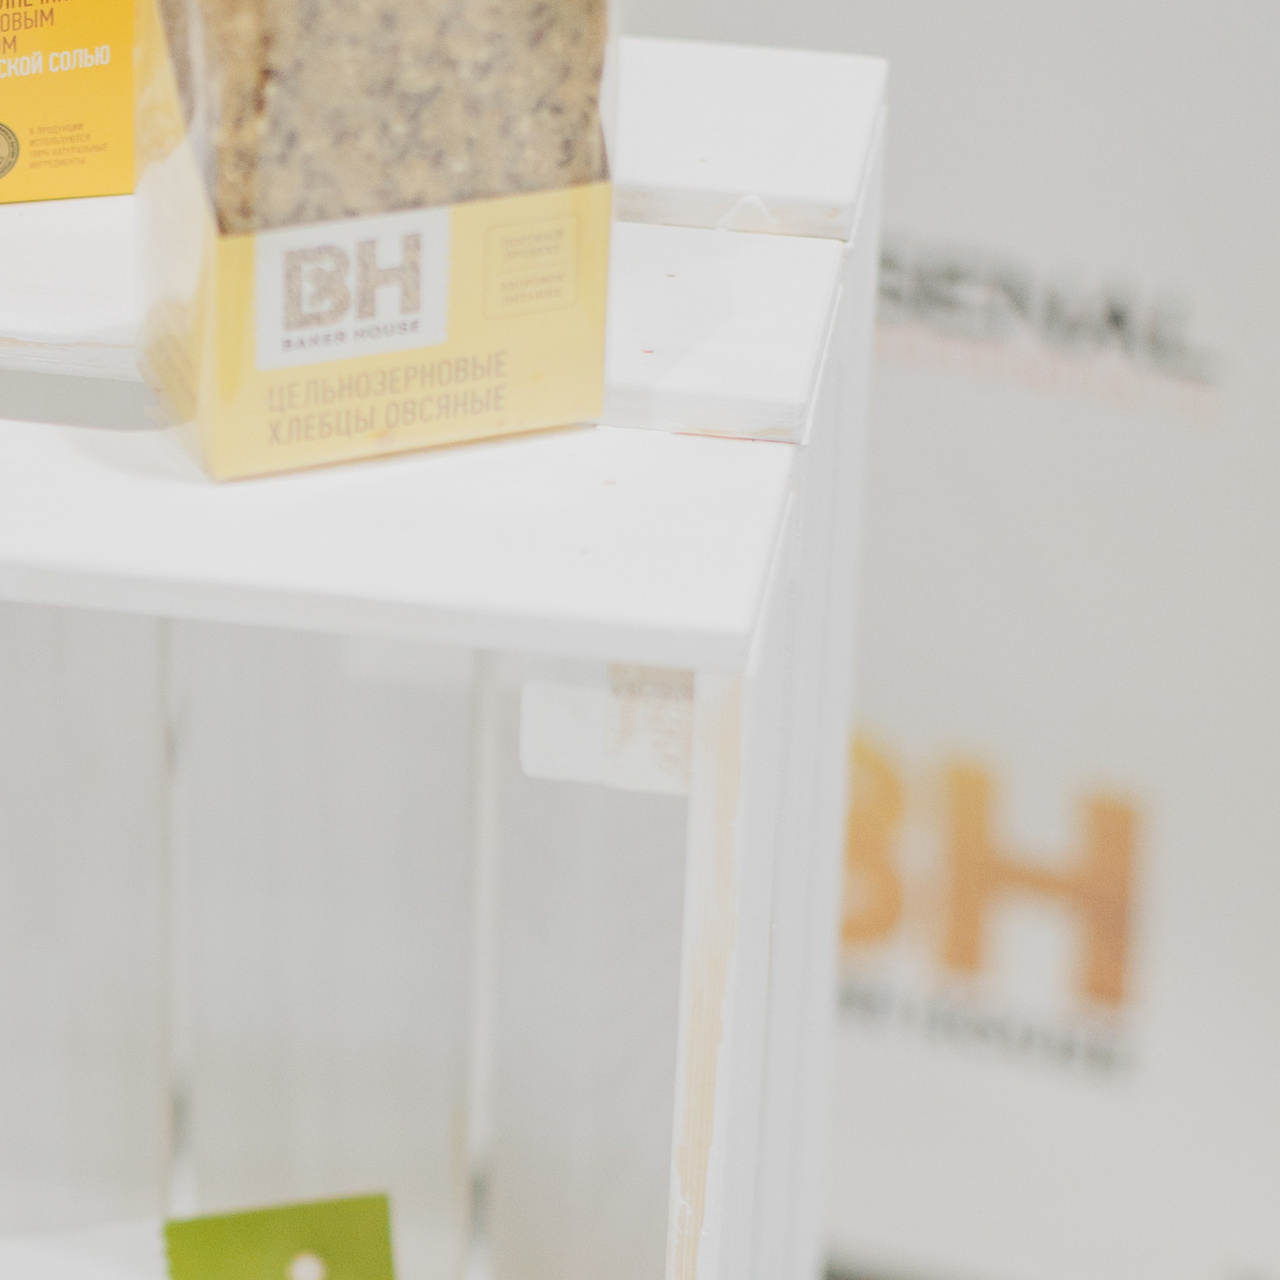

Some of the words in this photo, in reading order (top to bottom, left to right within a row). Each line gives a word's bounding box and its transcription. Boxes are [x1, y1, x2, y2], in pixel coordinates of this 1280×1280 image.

[49, 44, 111, 72] СОЛЬЮ
[283, 233, 421, 331] BH
[268, 350, 507, 412] ЦЕЛЬНОЗЕРНОВЫЕ
[267, 405, 376, 447] ХЛЕБЦЫ
[383, 384, 507, 429] ОВСЯНЫЕ
